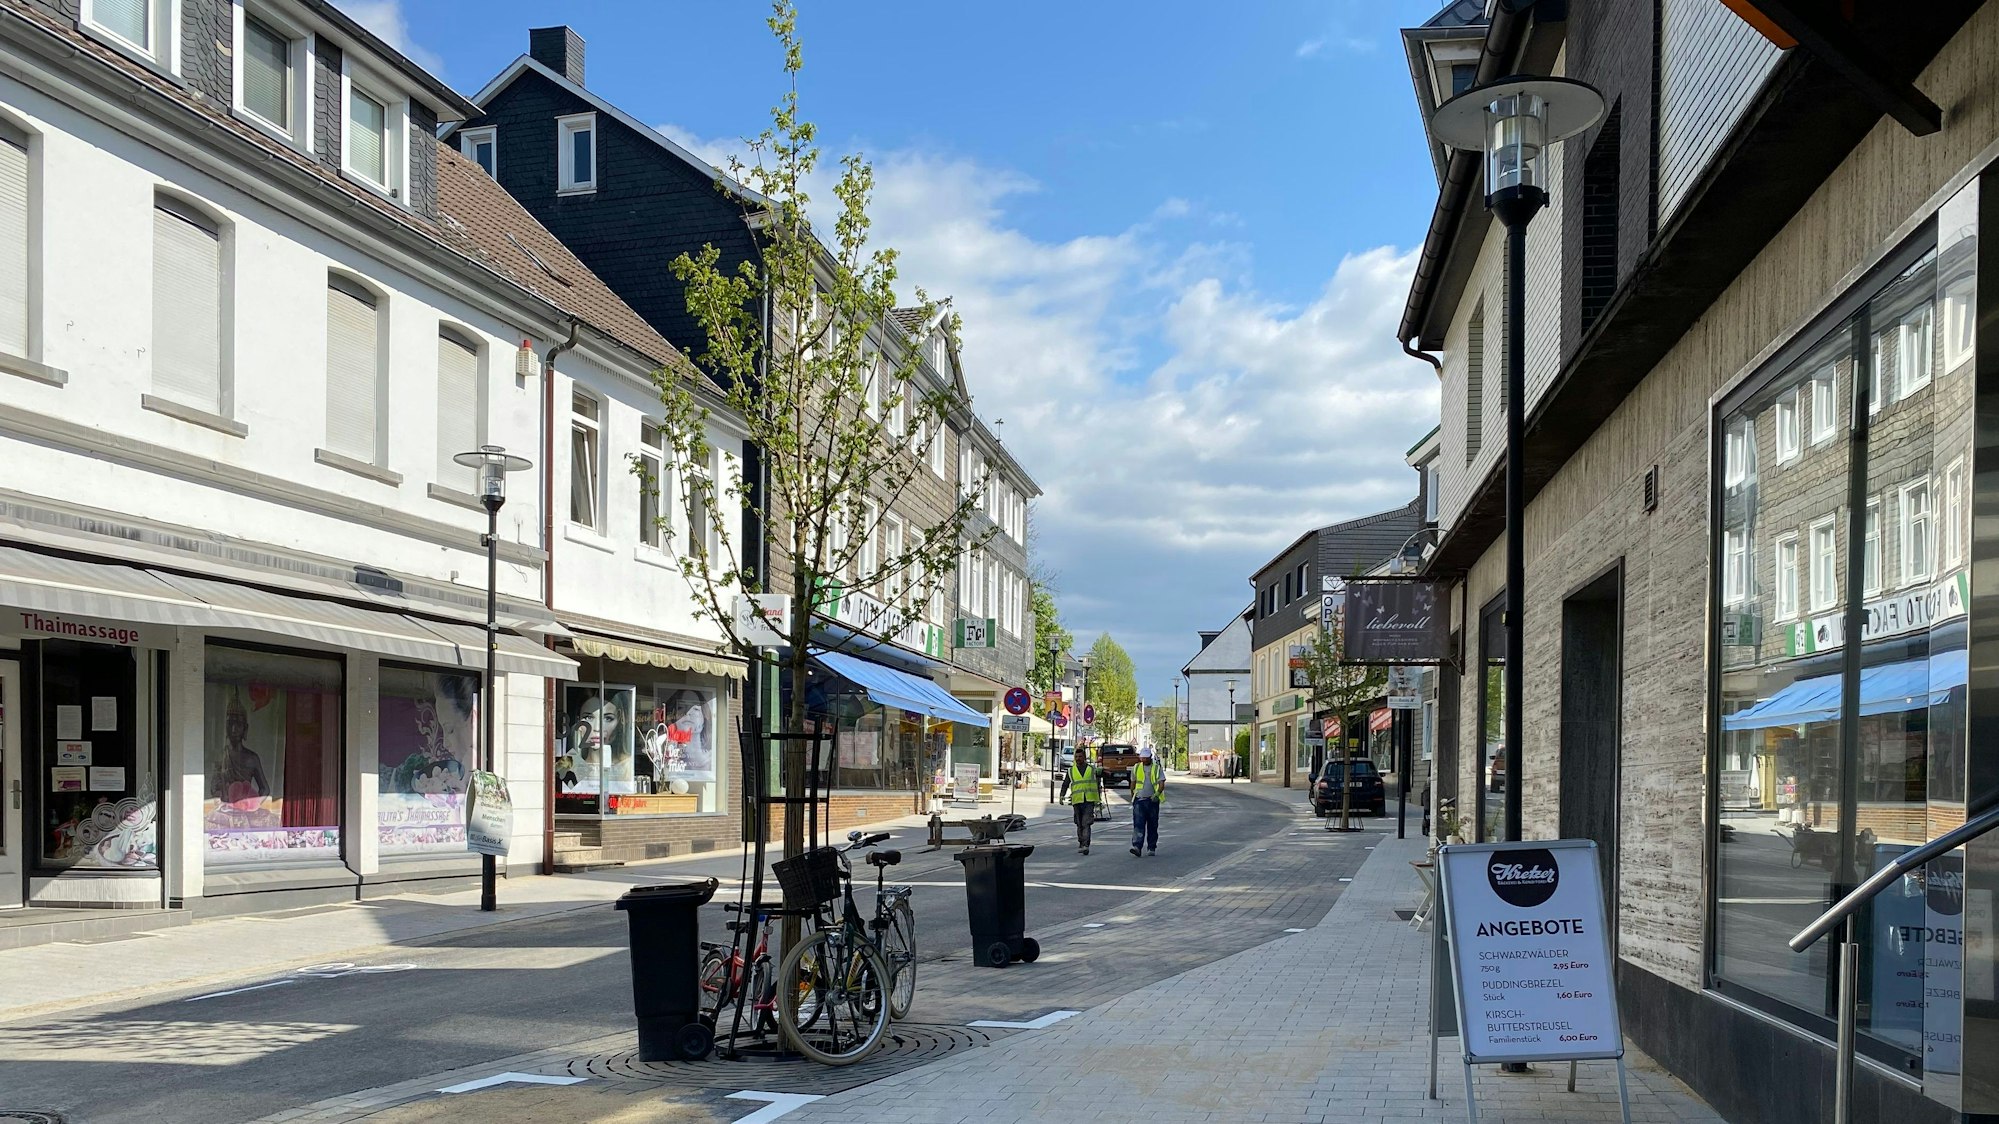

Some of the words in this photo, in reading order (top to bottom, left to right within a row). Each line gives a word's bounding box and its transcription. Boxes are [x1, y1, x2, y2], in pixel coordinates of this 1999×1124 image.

[857, 598, 880, 631] FOTO
[1366, 613, 1431, 630] liebevoll
[20, 612, 139, 644] Thaimassage
[1490, 863, 1556, 884] Kretzer
[1476, 919, 1585, 937] ANGEBOTE
[1479, 949, 1569, 961] SCHWARZWÄLDER
[1480, 965, 1495, 973] 750
[1495, 965, 1501, 974] g
[1553, 962, 1569, 970] 2,95
[1570, 961, 1589, 969] Euro
[1482, 979, 1565, 990] PUDDINGBREZEL
[1483, 993, 1506, 1001] Stück
[1556, 992, 1572, 1000] 1,60
[1574, 991, 1593, 999] Euro
[1485, 1010, 1526, 1020] KIRSCH-
[1487, 1021, 1574, 1033] BUTTERSTREUSEL
[1488, 1035, 1542, 1044] Familienstück
[1559, 1034, 1578, 1042] 6,00
[1579, 1033, 1598, 1041] Euro
